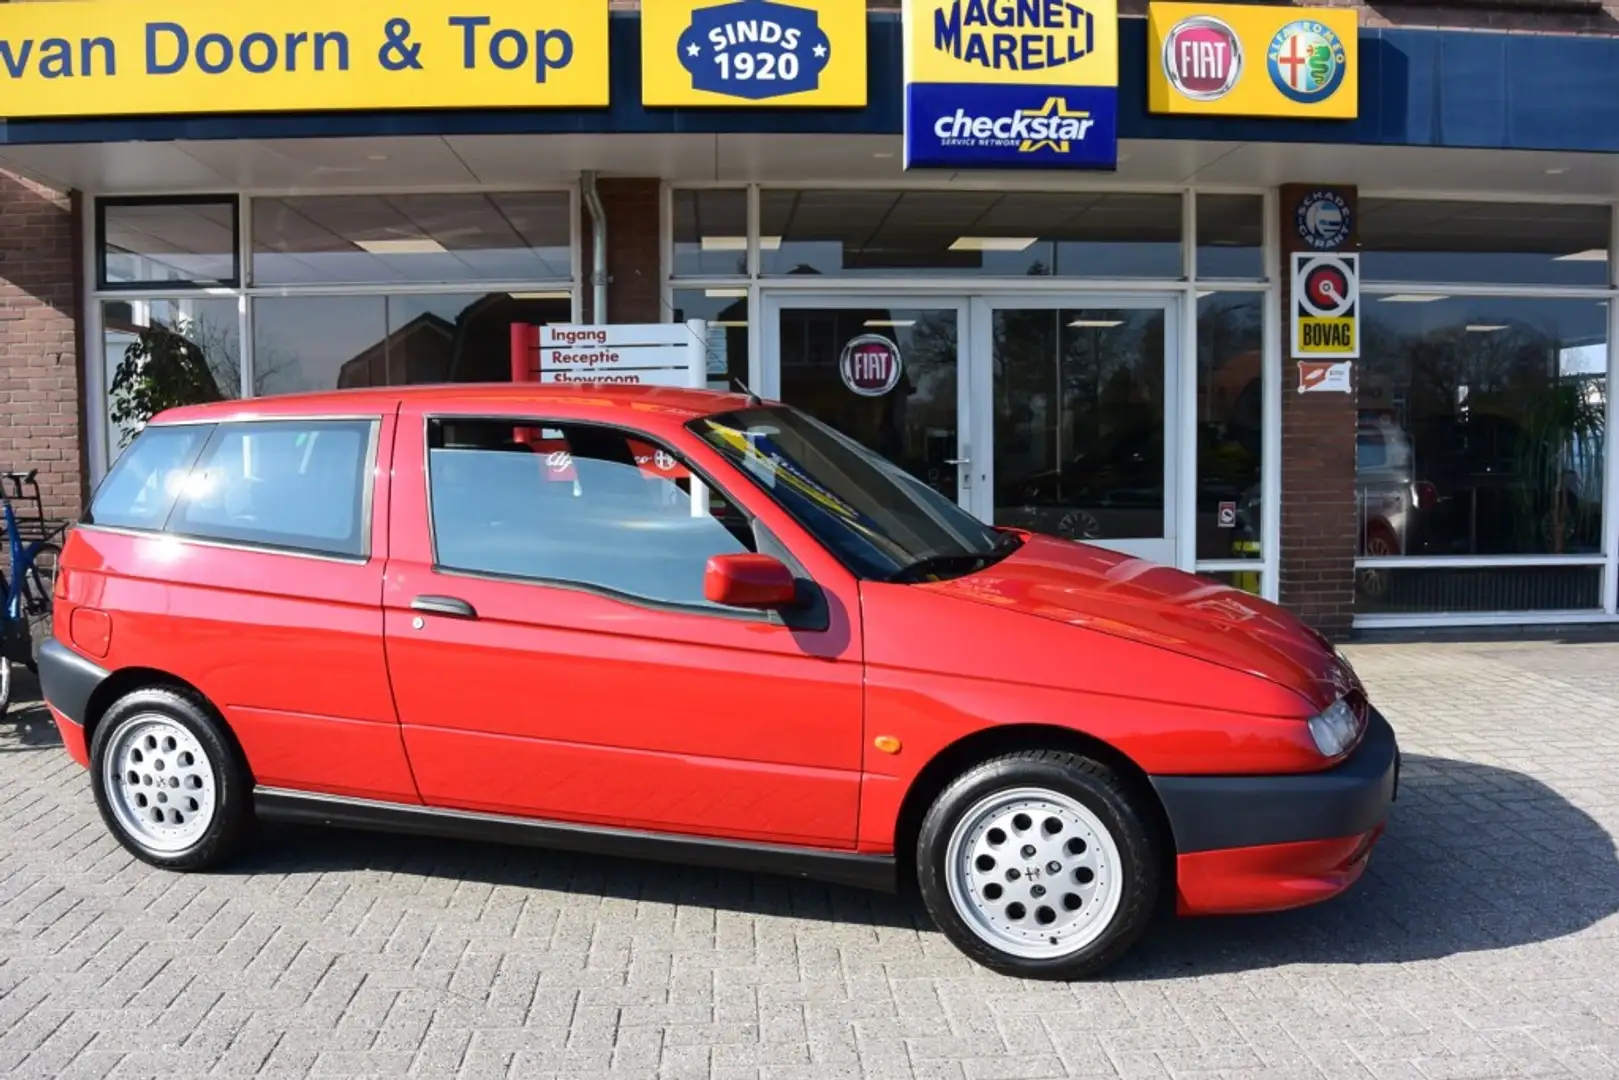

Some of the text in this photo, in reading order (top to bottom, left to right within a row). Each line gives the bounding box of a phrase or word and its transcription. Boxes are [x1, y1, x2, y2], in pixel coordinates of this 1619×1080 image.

[708, 20, 801, 51] SINDS
[934, 0, 1094, 43] MAGNETI
[0, 16, 574, 83] van Doorn & Top
[934, 20, 1094, 70] MARELLI
[714, 52, 799, 80] 1920
[1181, 41, 1227, 79] FIAT
[934, 108, 1094, 140] checkstar
[941, 138, 1020, 147] SERVICE NETWORK
[1297, 191, 1350, 217] SCHADE
[551, 327, 607, 344] Ingang
[1303, 323, 1351, 347] BOVAG
[552, 350, 620, 366] Receptie
[854, 352, 888, 380] FIAT
